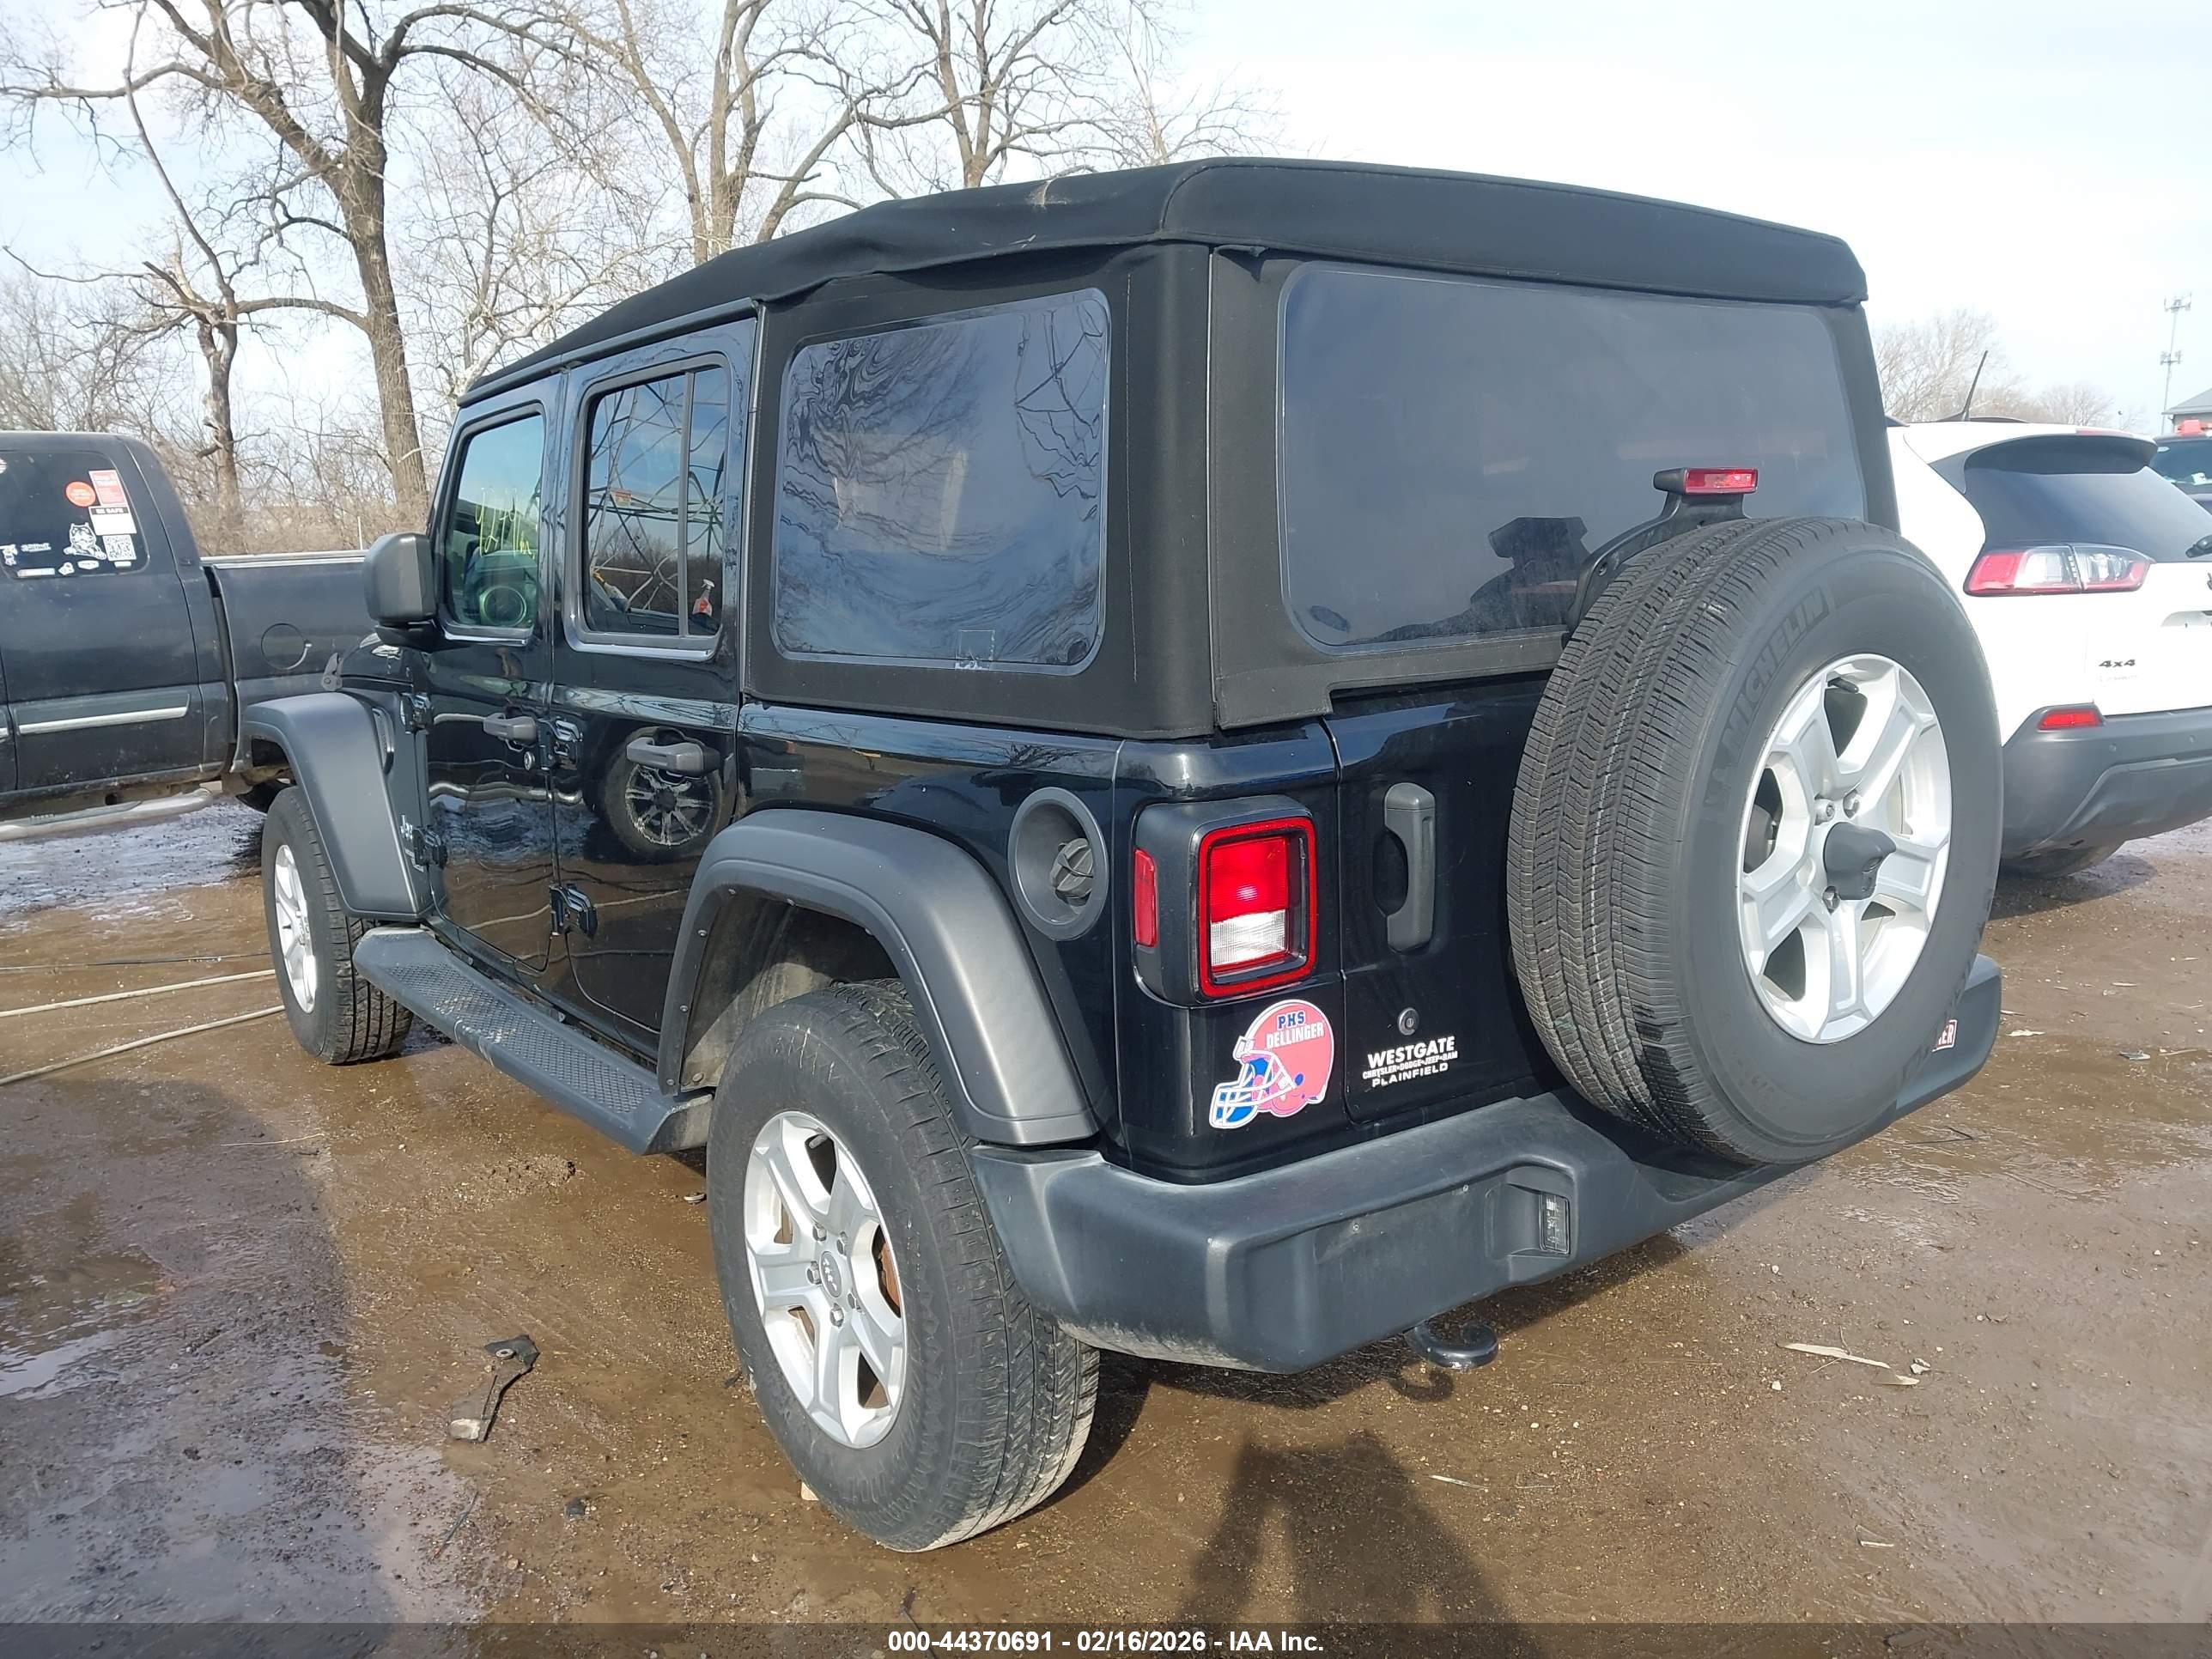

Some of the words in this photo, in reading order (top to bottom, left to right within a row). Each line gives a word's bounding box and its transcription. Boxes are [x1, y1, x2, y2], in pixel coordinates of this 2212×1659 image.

[1721, 587, 1828, 758] MICHELIN
[1277, 1011, 1305, 1030] PHS
[1266, 1022, 1324, 1048] DELLINGER
[1367, 1036, 1455, 1069] WESTGATE
[1371, 1062, 1449, 1088] PLAINFIELD
